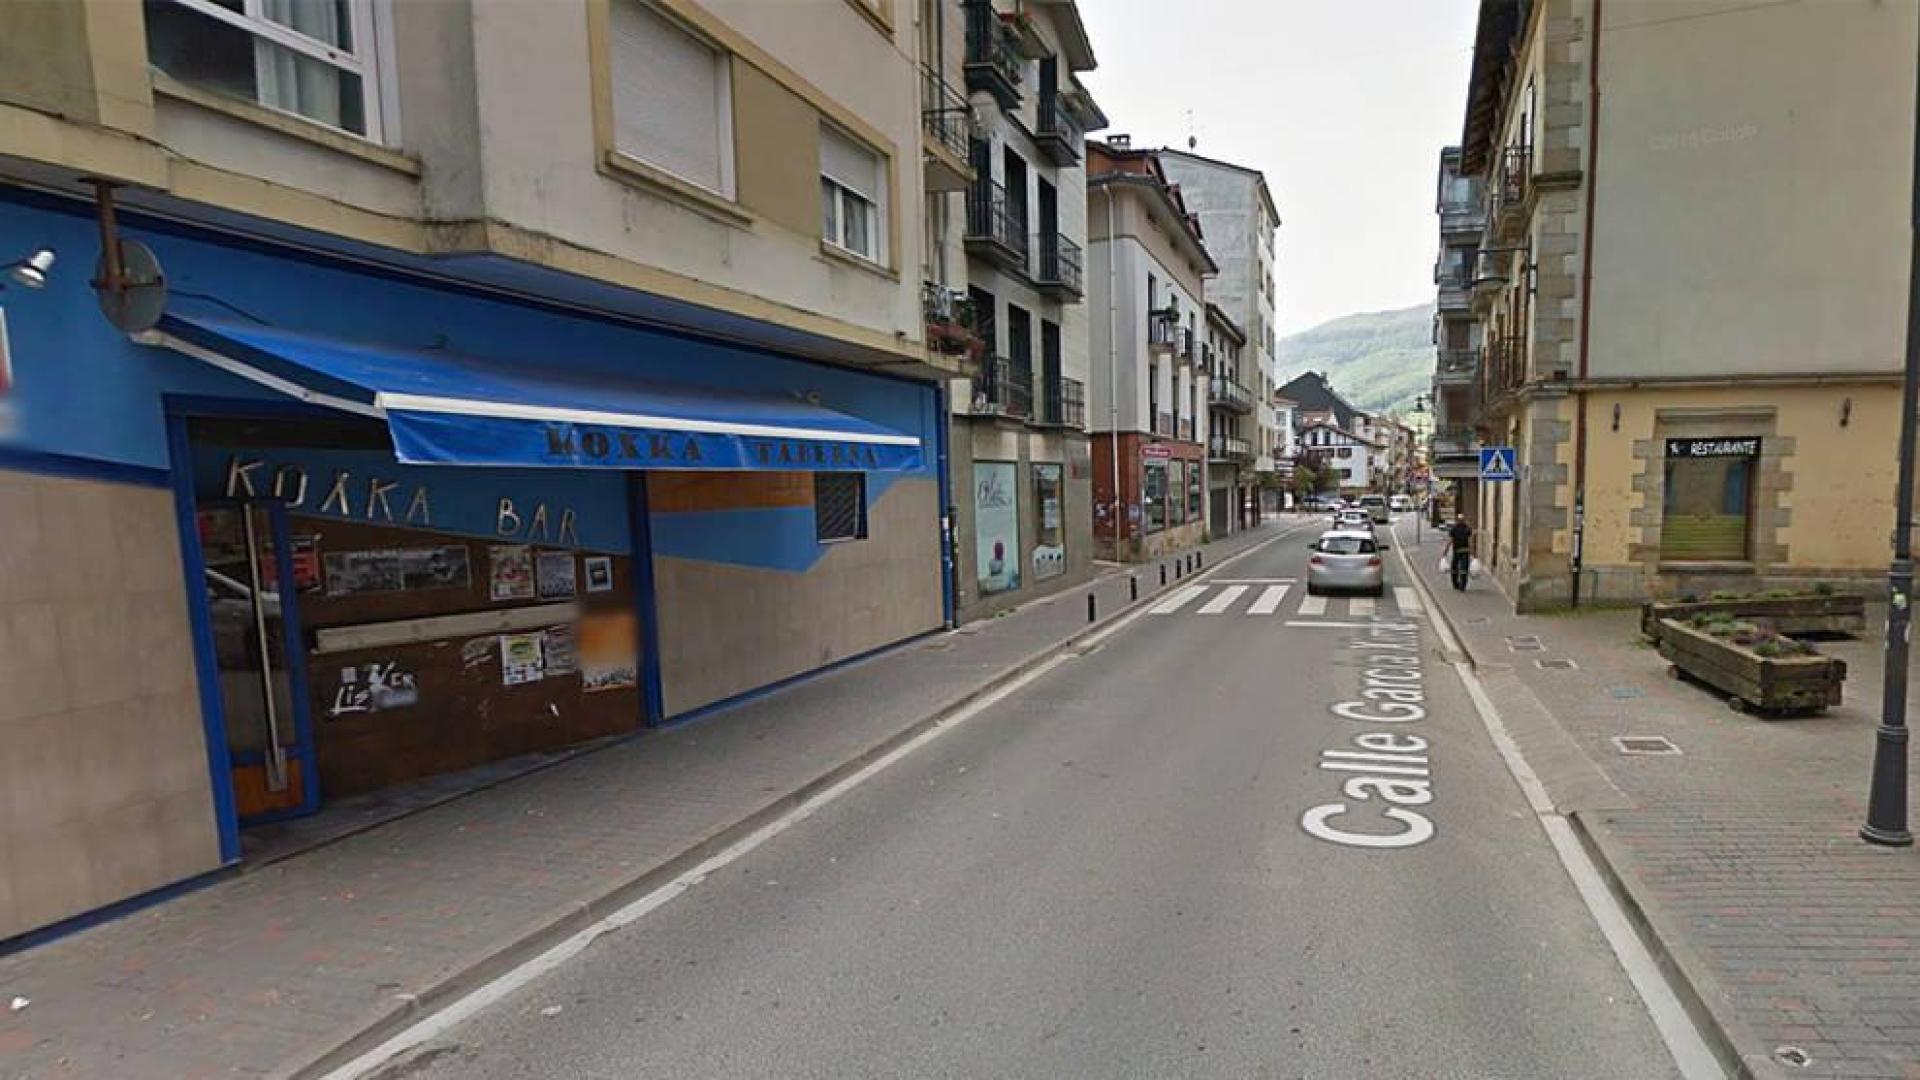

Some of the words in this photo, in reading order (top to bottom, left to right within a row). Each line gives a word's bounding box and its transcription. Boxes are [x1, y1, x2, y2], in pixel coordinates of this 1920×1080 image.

[1690, 439, 1757, 457] RESTAURANTE
[226, 457, 431, 526] KOXKA
[496, 497, 580, 546] BAR
